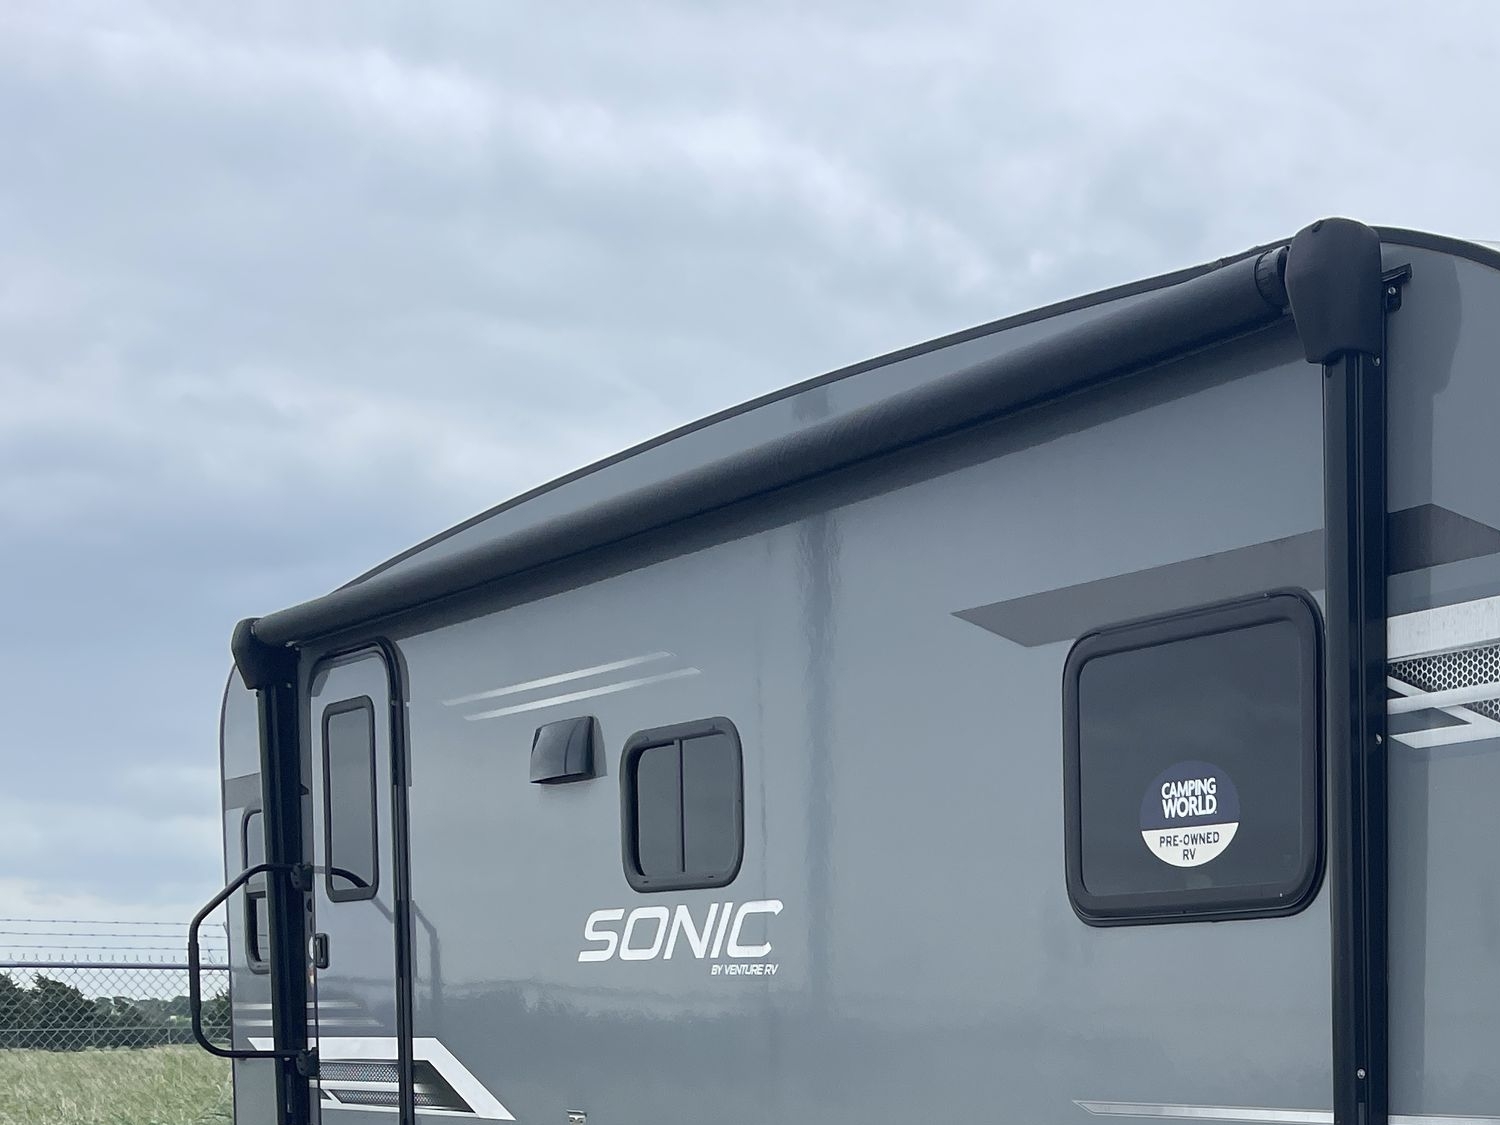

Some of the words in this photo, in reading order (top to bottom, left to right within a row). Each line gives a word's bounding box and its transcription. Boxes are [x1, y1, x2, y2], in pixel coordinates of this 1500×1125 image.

[1161, 777, 1217, 799] CAMPING
[1162, 795, 1217, 818] WORLD
[1159, 832, 1220, 847] PRE-OWNED
[1182, 848, 1197, 860] RV
[577, 899, 784, 962] SONIC
[711, 964, 724, 975] BY
[724, 964, 765, 976] VENTURE
[764, 964, 779, 975] RV
